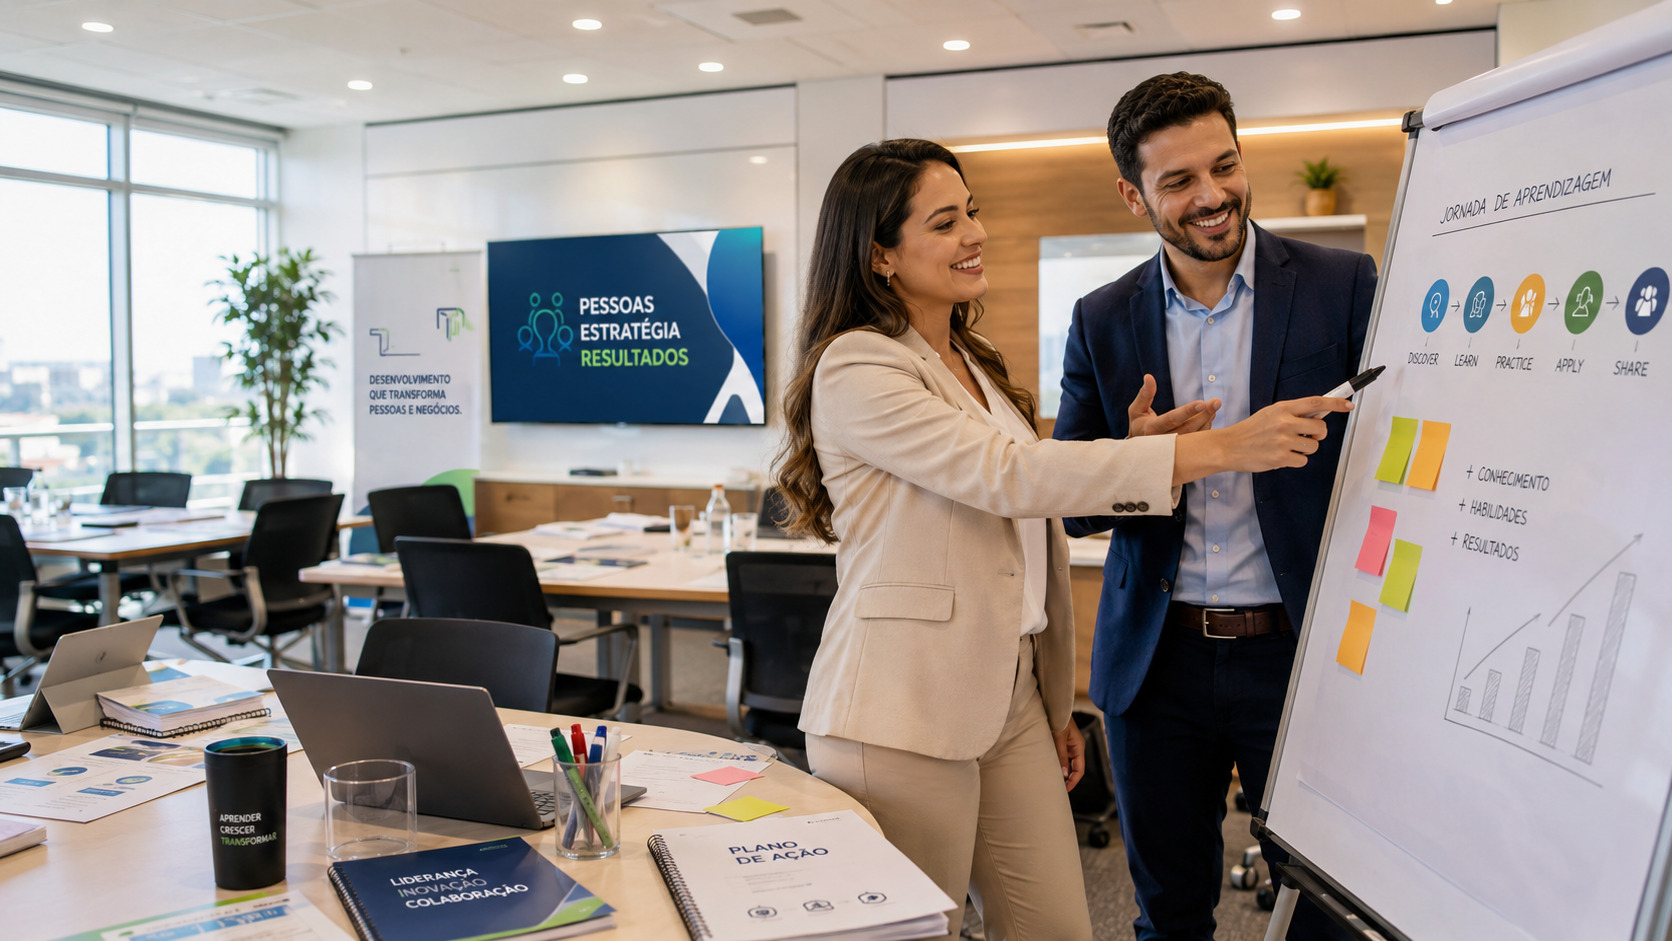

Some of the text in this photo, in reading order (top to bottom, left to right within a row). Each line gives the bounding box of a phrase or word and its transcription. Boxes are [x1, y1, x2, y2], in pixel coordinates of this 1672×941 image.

[1439, 168, 1612, 224] JORNADA DE APRENDIZAGEM
[579, 296, 654, 315] PESSOAS
[580, 318, 681, 341] ESTRATÉGIA
[581, 348, 689, 367] RESULTADOS
[1454, 353, 1479, 367] LEARN
[1495, 356, 1534, 371] PRACTICE
[1554, 357, 1584, 374] APPLY
[1612, 360, 1650, 377] SHARE
[369, 374, 451, 385] DESENVOLVIMENTO
[369, 389, 446, 400] QUE TRANSFORMA
[369, 401, 462, 415] PESSOAS E NEGÓCIOS.
[1477, 466, 1550, 491] CONHECIMENTO
[1470, 499, 1527, 525] HABILIDADES
[1462, 532, 1519, 561] RESULTADOS
[219, 812, 262, 823] APRENDER
[220, 825, 255, 834] CRESCER
[220, 831, 277, 846] TRANSFORMAR
[728, 841, 798, 854] PLANO
[735, 847, 829, 865] DE AÇÃO
[390, 868, 479, 886] LIDERANÇA
[397, 878, 488, 898] INOVAÇÃO
[405, 884, 529, 909] COLABORAÇÃO
